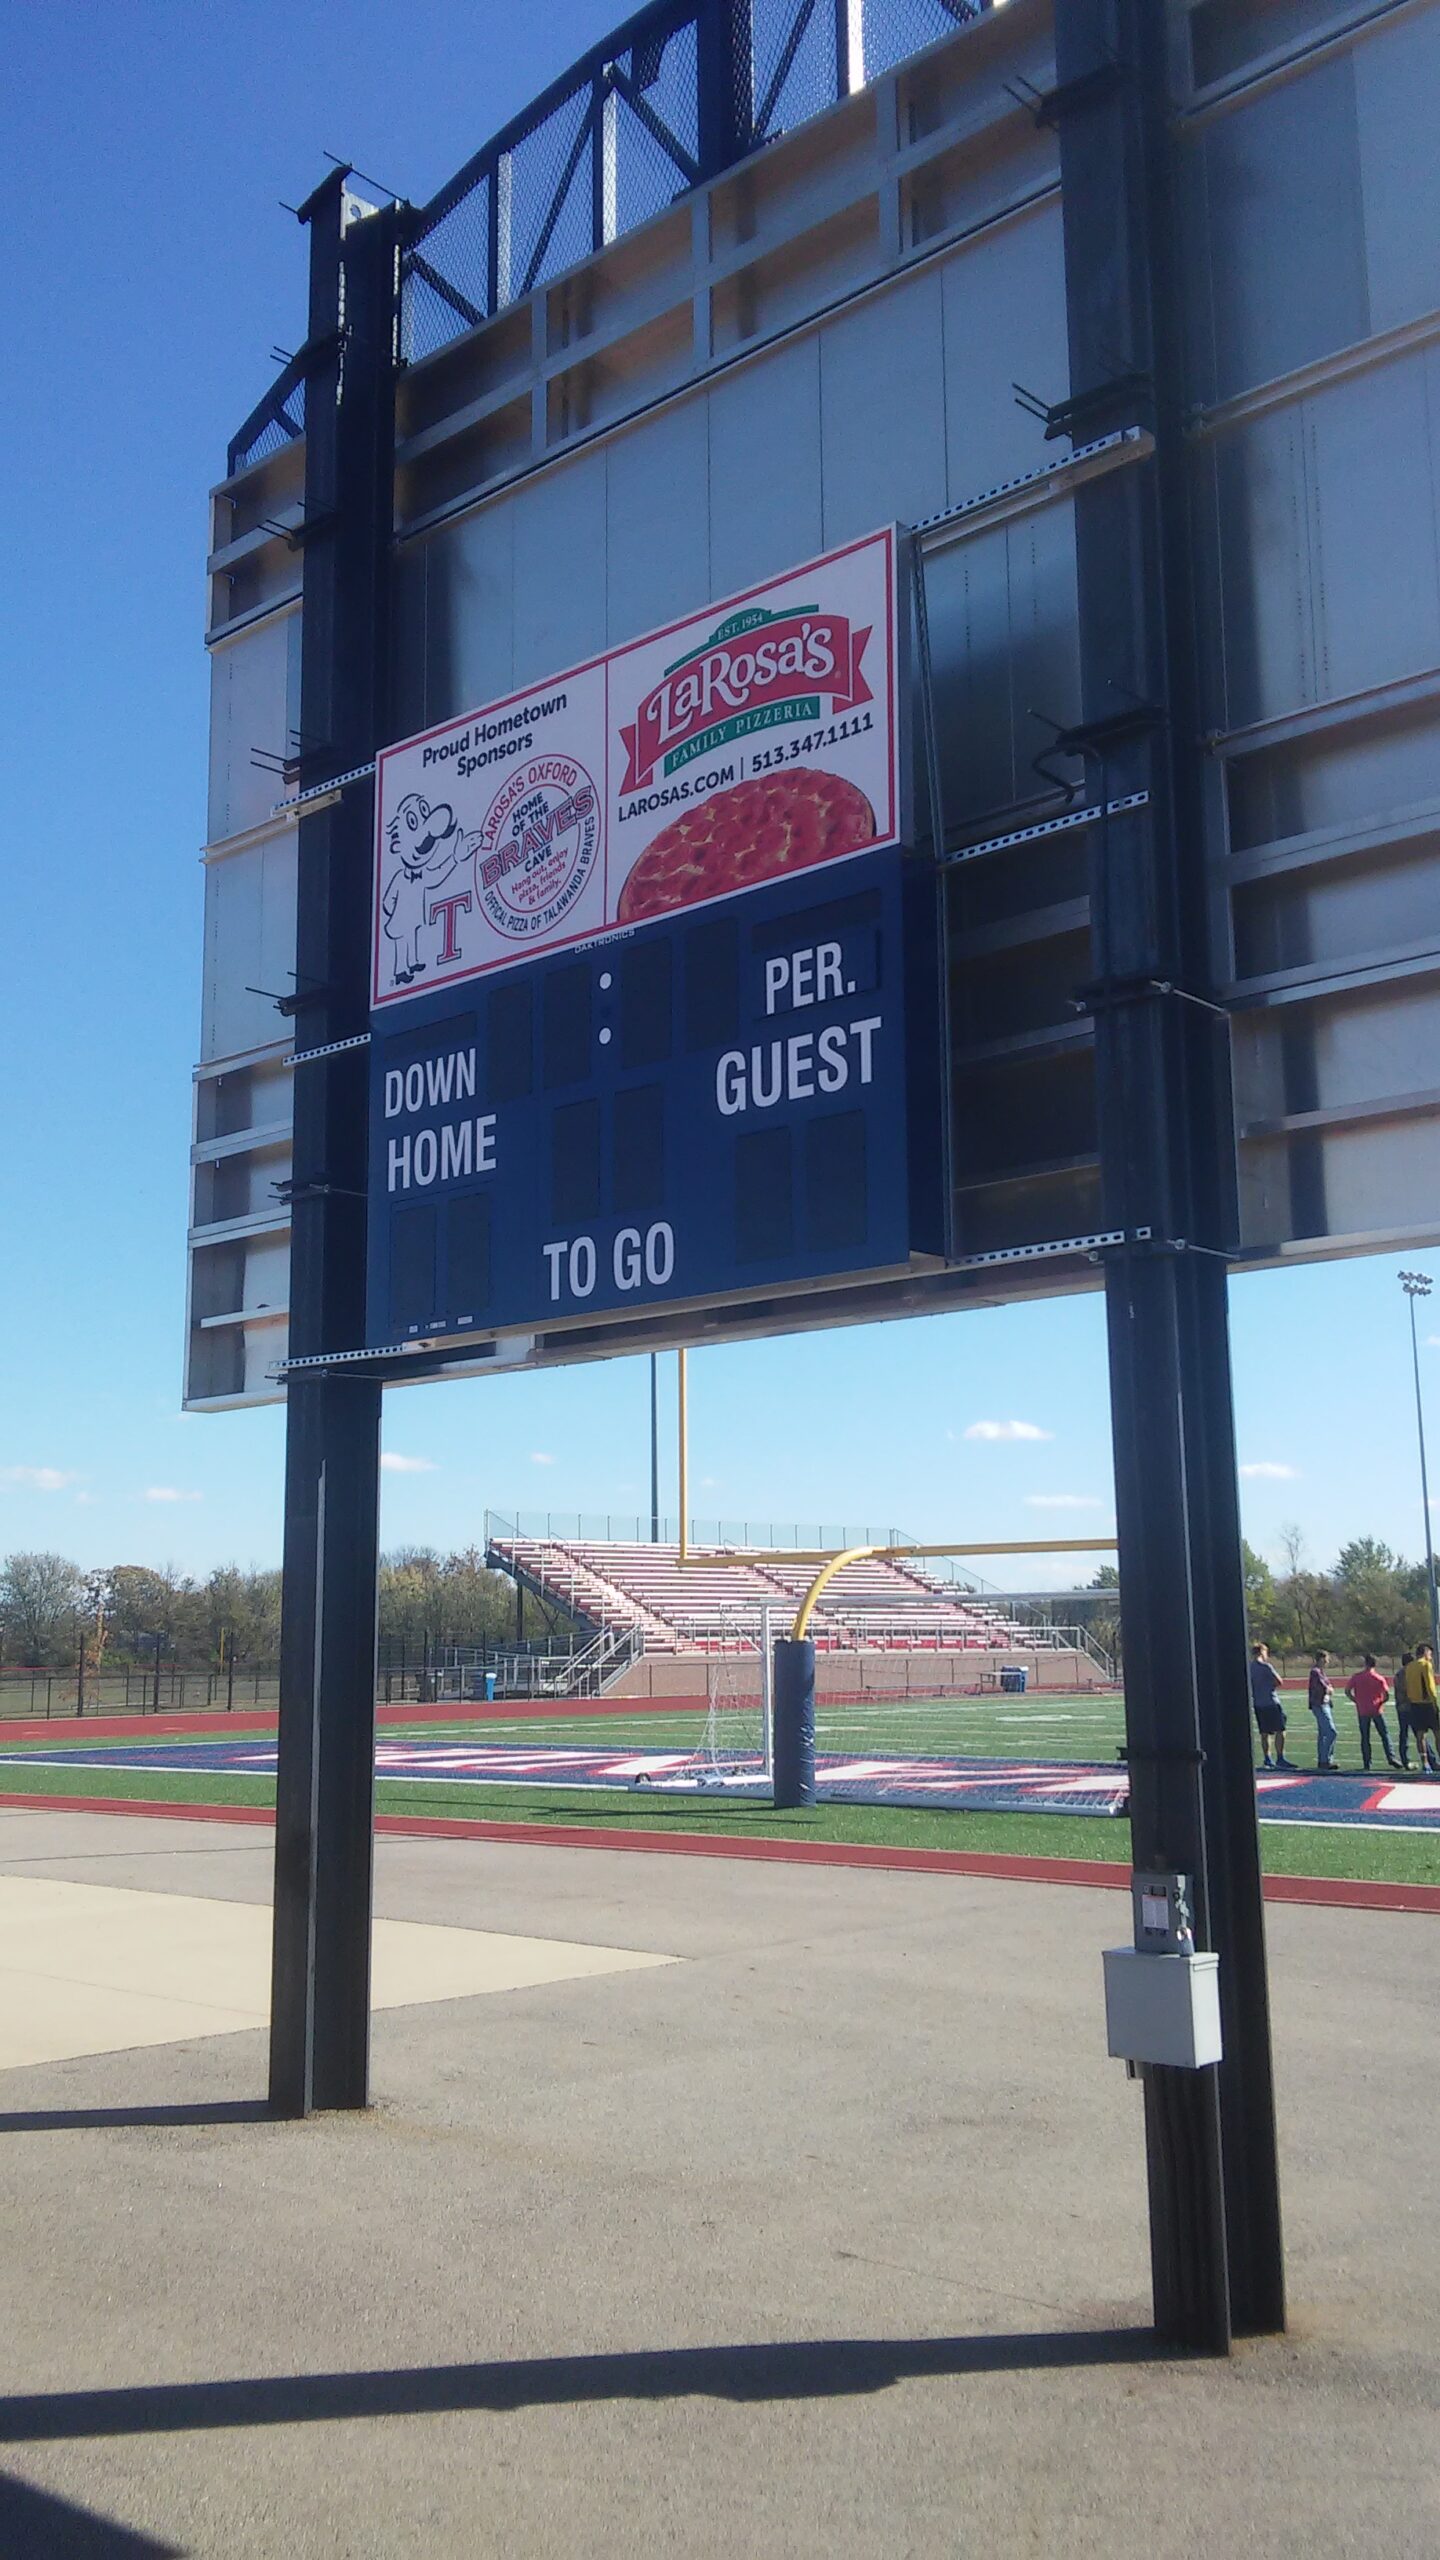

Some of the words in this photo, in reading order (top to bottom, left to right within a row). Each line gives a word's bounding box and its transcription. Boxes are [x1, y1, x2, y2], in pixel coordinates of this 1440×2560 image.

[717, 622, 740, 640] EST.
[741, 612, 763, 629] 1954
[646, 622, 836, 745] LaRosa's
[422, 731, 470, 768] Proud
[474, 693, 568, 745] Hometown
[457, 731, 534, 777] Sponsors
[618, 765, 735, 822] LAROSAS.COM
[752, 712, 874, 773] 513.347.1111
[671, 726, 728, 769] FAMILY
[735, 701, 813, 735] PIZZERIA
[479, 785, 595, 889] BRAVES
[482, 775, 525, 851] LAROSA'S
[528, 762, 578, 787] OXFORD
[512, 792, 544, 823] HOME
[512, 820, 526, 837] OF
[528, 801, 550, 821] THE
[506, 915, 529, 932] PIZZA
[530, 913, 543, 931] OF
[543, 868, 587, 925] TALAWANDA
[580, 816, 596, 865] BRAVES
[511, 876, 532, 894] Hang
[548, 847, 569, 867] enjoy
[524, 845, 552, 873] CAVE
[540, 862, 566, 884] friends
[429, 890, 472, 966] T
[765, 941, 856, 1015] PER.
[384, 1048, 476, 1119] DOWN
[715, 1016, 882, 1116] GUEST
[387, 1114, 497, 1192] HOME
[543, 1235, 596, 1300] TO
[612, 1221, 674, 1291] GO
